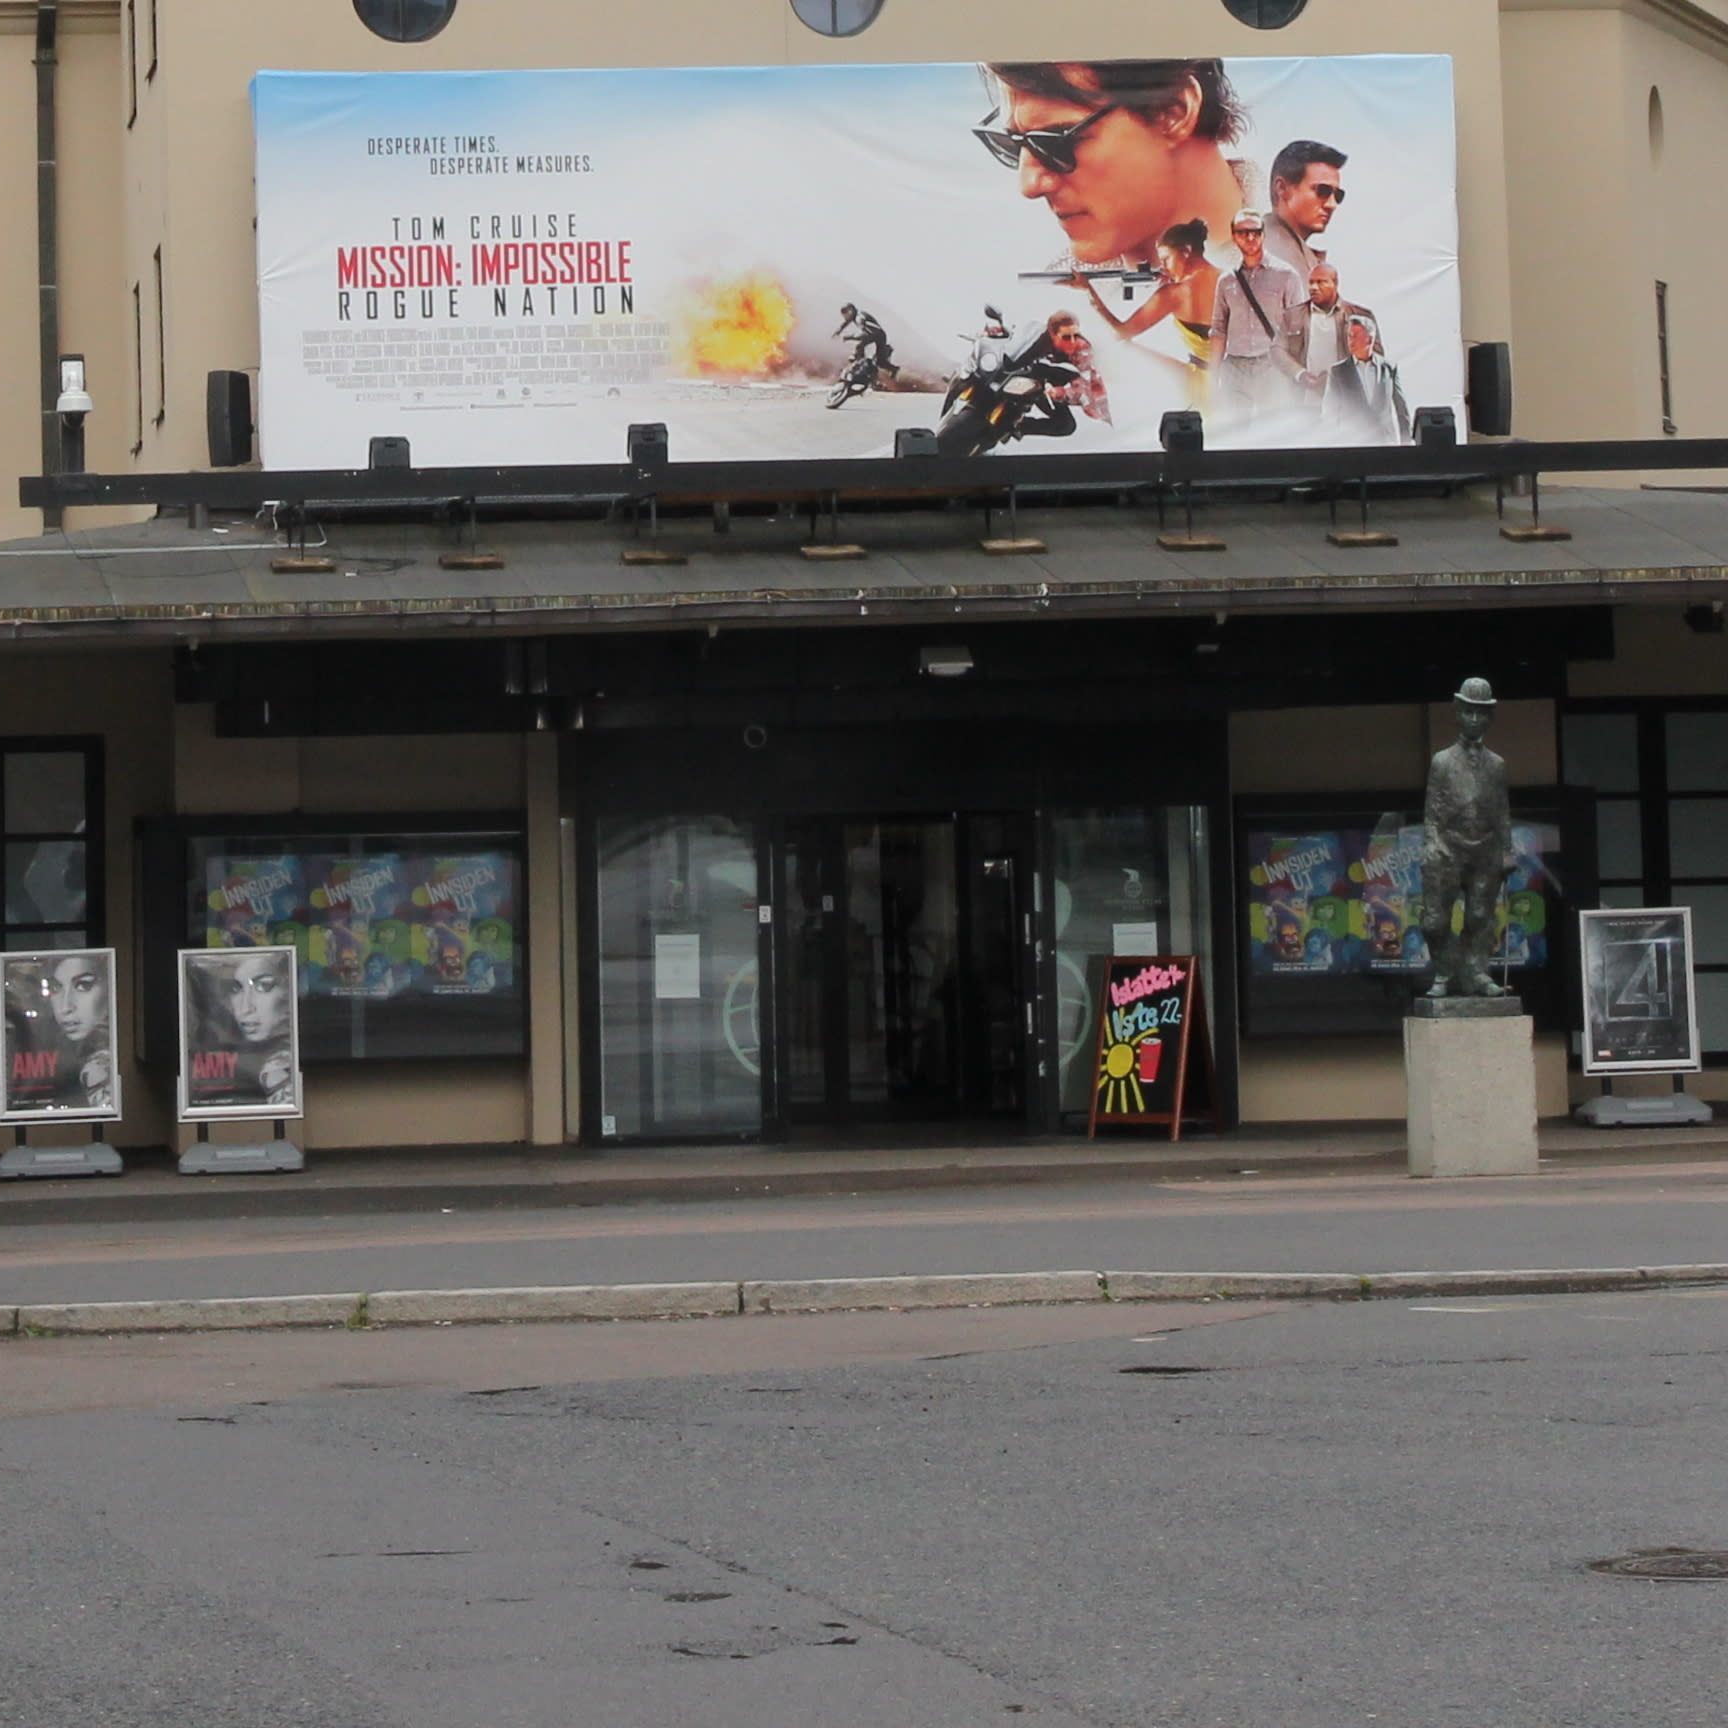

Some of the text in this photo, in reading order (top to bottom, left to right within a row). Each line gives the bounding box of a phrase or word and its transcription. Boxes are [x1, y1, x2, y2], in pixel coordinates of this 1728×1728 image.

[368, 136, 499, 155] DESPERATE TIMES.
[430, 155, 594, 175] DESPERATE MEASURES.
[392, 214, 577, 241] TOM CRUISE
[337, 241, 632, 289] MISSION: IMPOSSIBLE
[339, 285, 633, 321] ROGUE NATION
[12, 1051, 59, 1079] AMY
[192, 1051, 239, 1079] AMY
